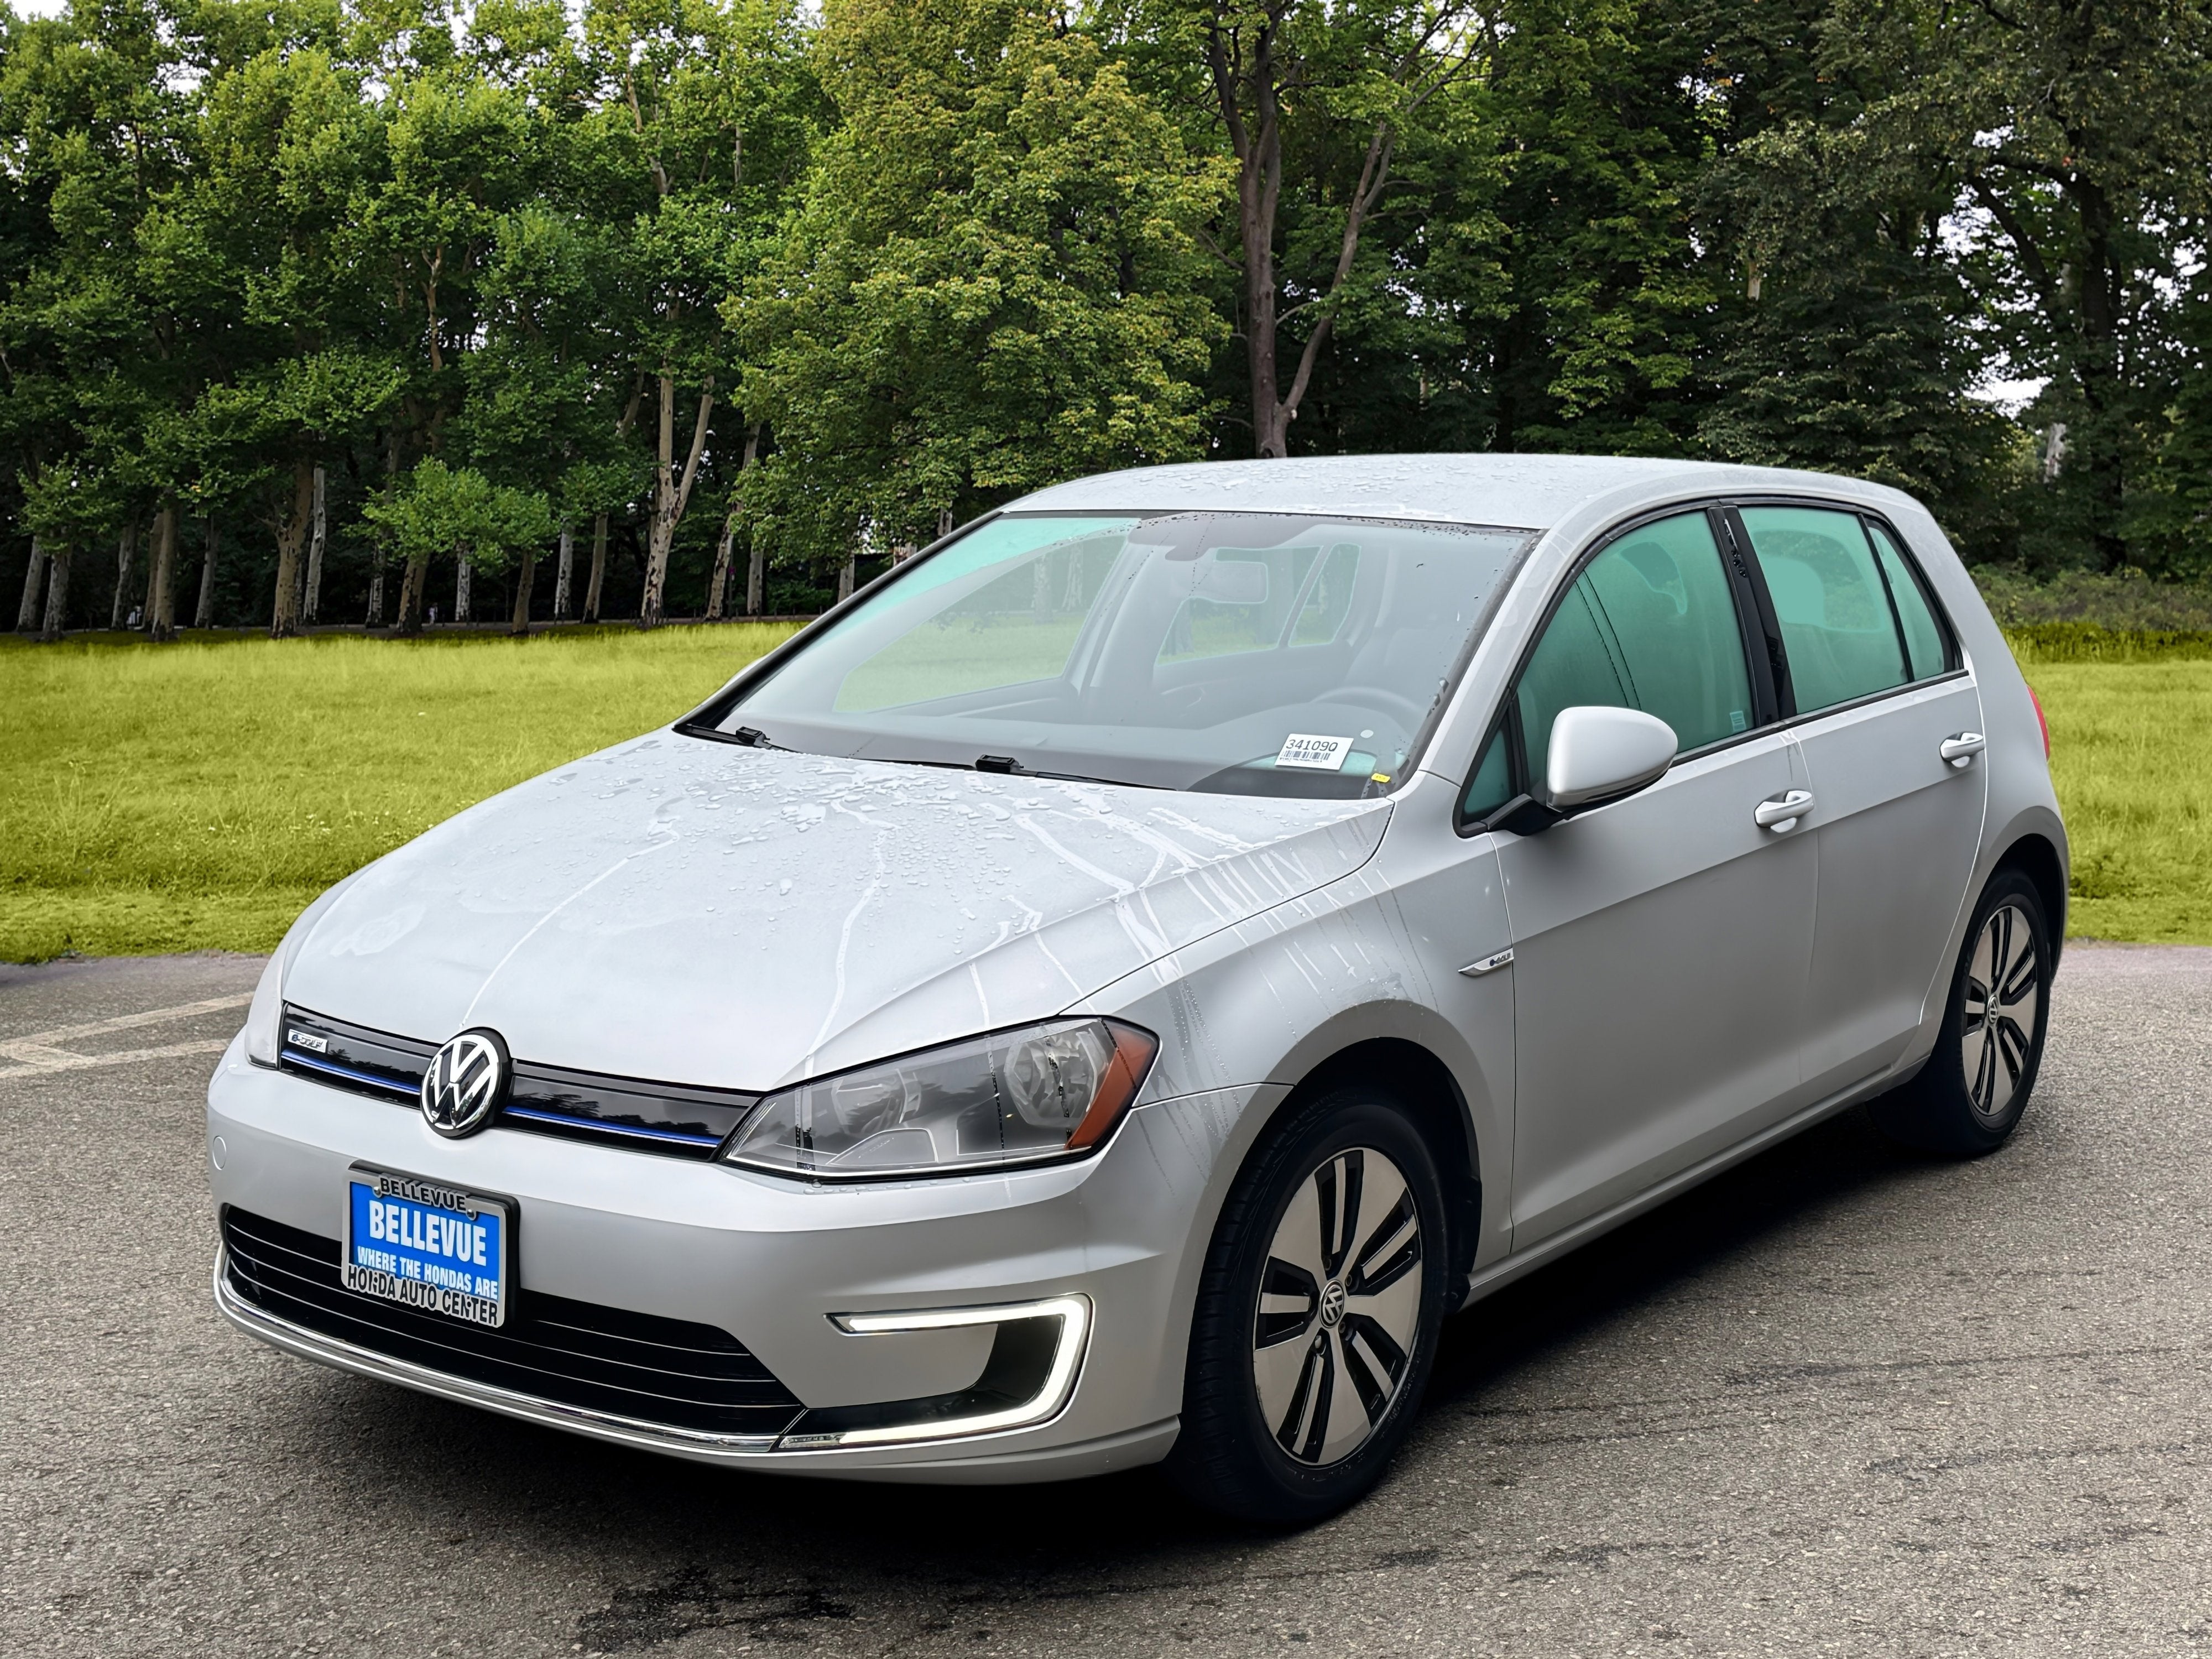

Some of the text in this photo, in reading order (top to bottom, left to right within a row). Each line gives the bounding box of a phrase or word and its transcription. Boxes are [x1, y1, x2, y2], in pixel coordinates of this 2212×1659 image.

[380, 1177, 466, 1211] BELLEVUE
[369, 1201, 487, 1266] BELLEVUE
[348, 1266, 498, 1326] HONDA AUTO CENTER
[357, 1246, 498, 1300] WHERE THE HONDAS ARE
